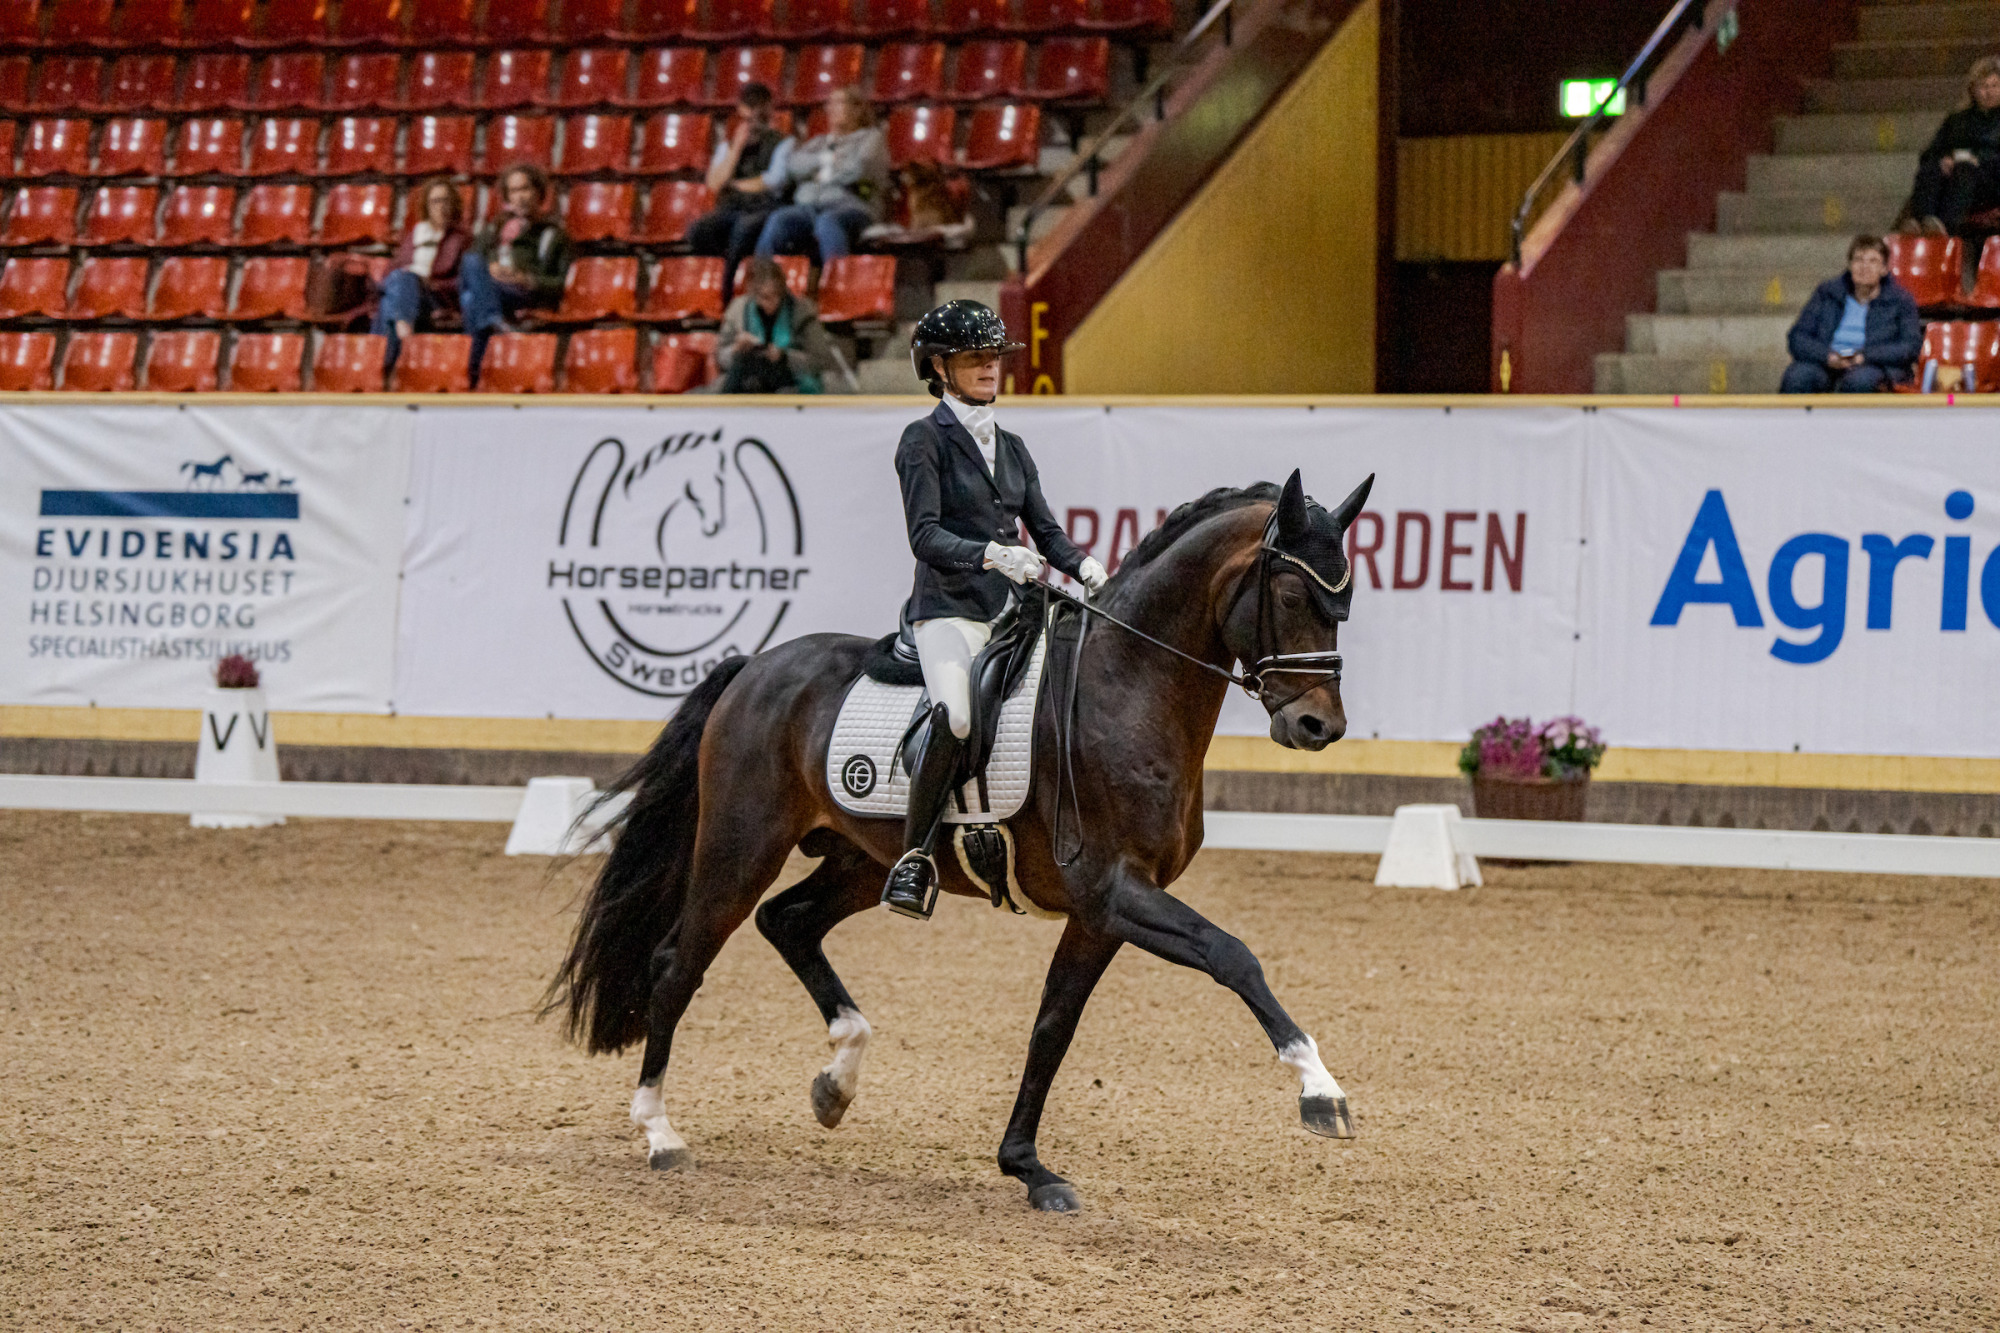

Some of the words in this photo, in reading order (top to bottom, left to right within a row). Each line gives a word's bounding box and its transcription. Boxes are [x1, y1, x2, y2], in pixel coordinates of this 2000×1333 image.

[36, 529, 297, 561] EVIDENSIA
[33, 565, 297, 594] DJURSJUKHUSET
[547, 560, 810, 598] Horsepartner
[1649, 489, 2000, 664] Agri
[30, 600, 256, 630] HELSINGBORG
[28, 635, 292, 664] SPECIALISTHÄSTSJUKHUS
[209, 712, 238, 750] V
[249, 712, 268, 749] V
